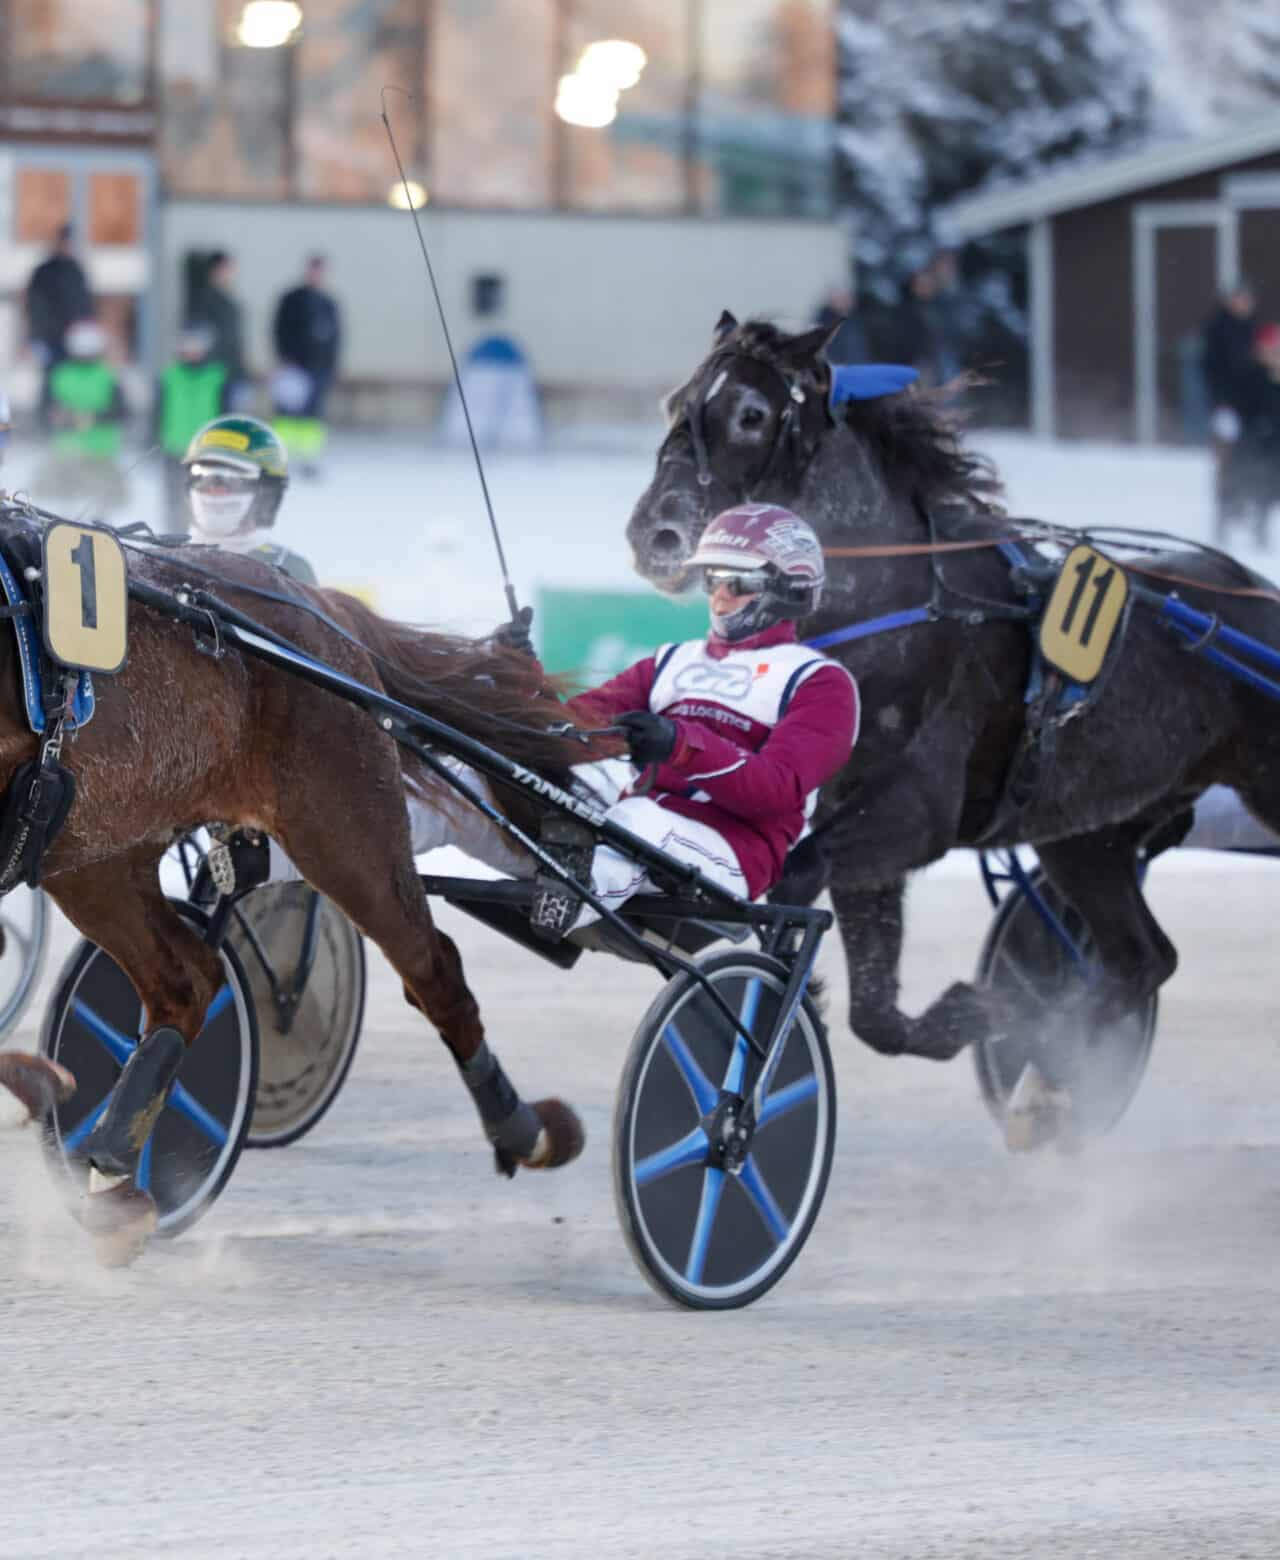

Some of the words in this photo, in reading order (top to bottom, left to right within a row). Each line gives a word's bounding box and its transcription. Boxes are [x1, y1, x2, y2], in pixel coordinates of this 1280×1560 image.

[70, 533, 98, 630] 1
[1061, 553, 1115, 648] 11
[511, 764, 607, 827] YANKEE
